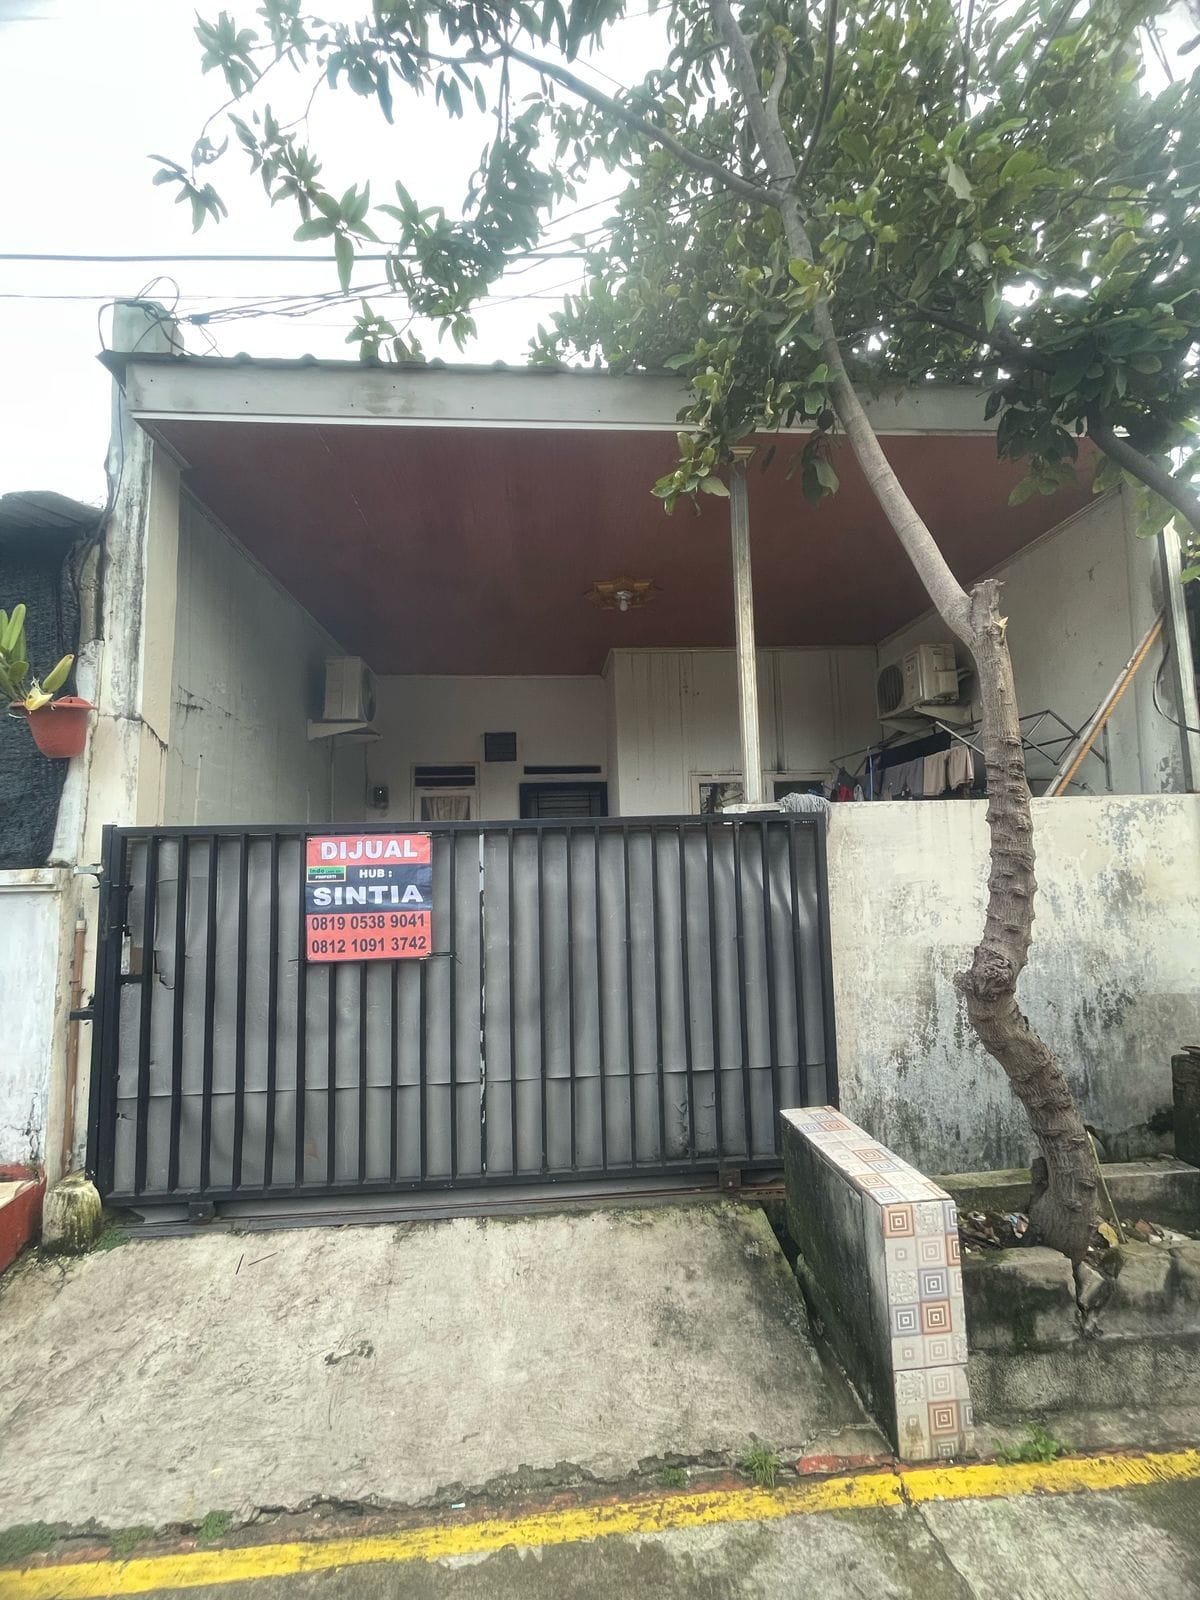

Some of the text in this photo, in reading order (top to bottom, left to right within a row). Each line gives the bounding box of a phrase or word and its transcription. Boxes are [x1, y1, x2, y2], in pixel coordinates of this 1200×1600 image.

[320, 840, 418, 860] DIJUAL
[359, 869, 384, 878] HUB
[313, 885, 424, 906] SINTIA
[312, 913, 425, 931] 0819 0538 9041
[312, 936, 426, 954] 0812 1091 3742
